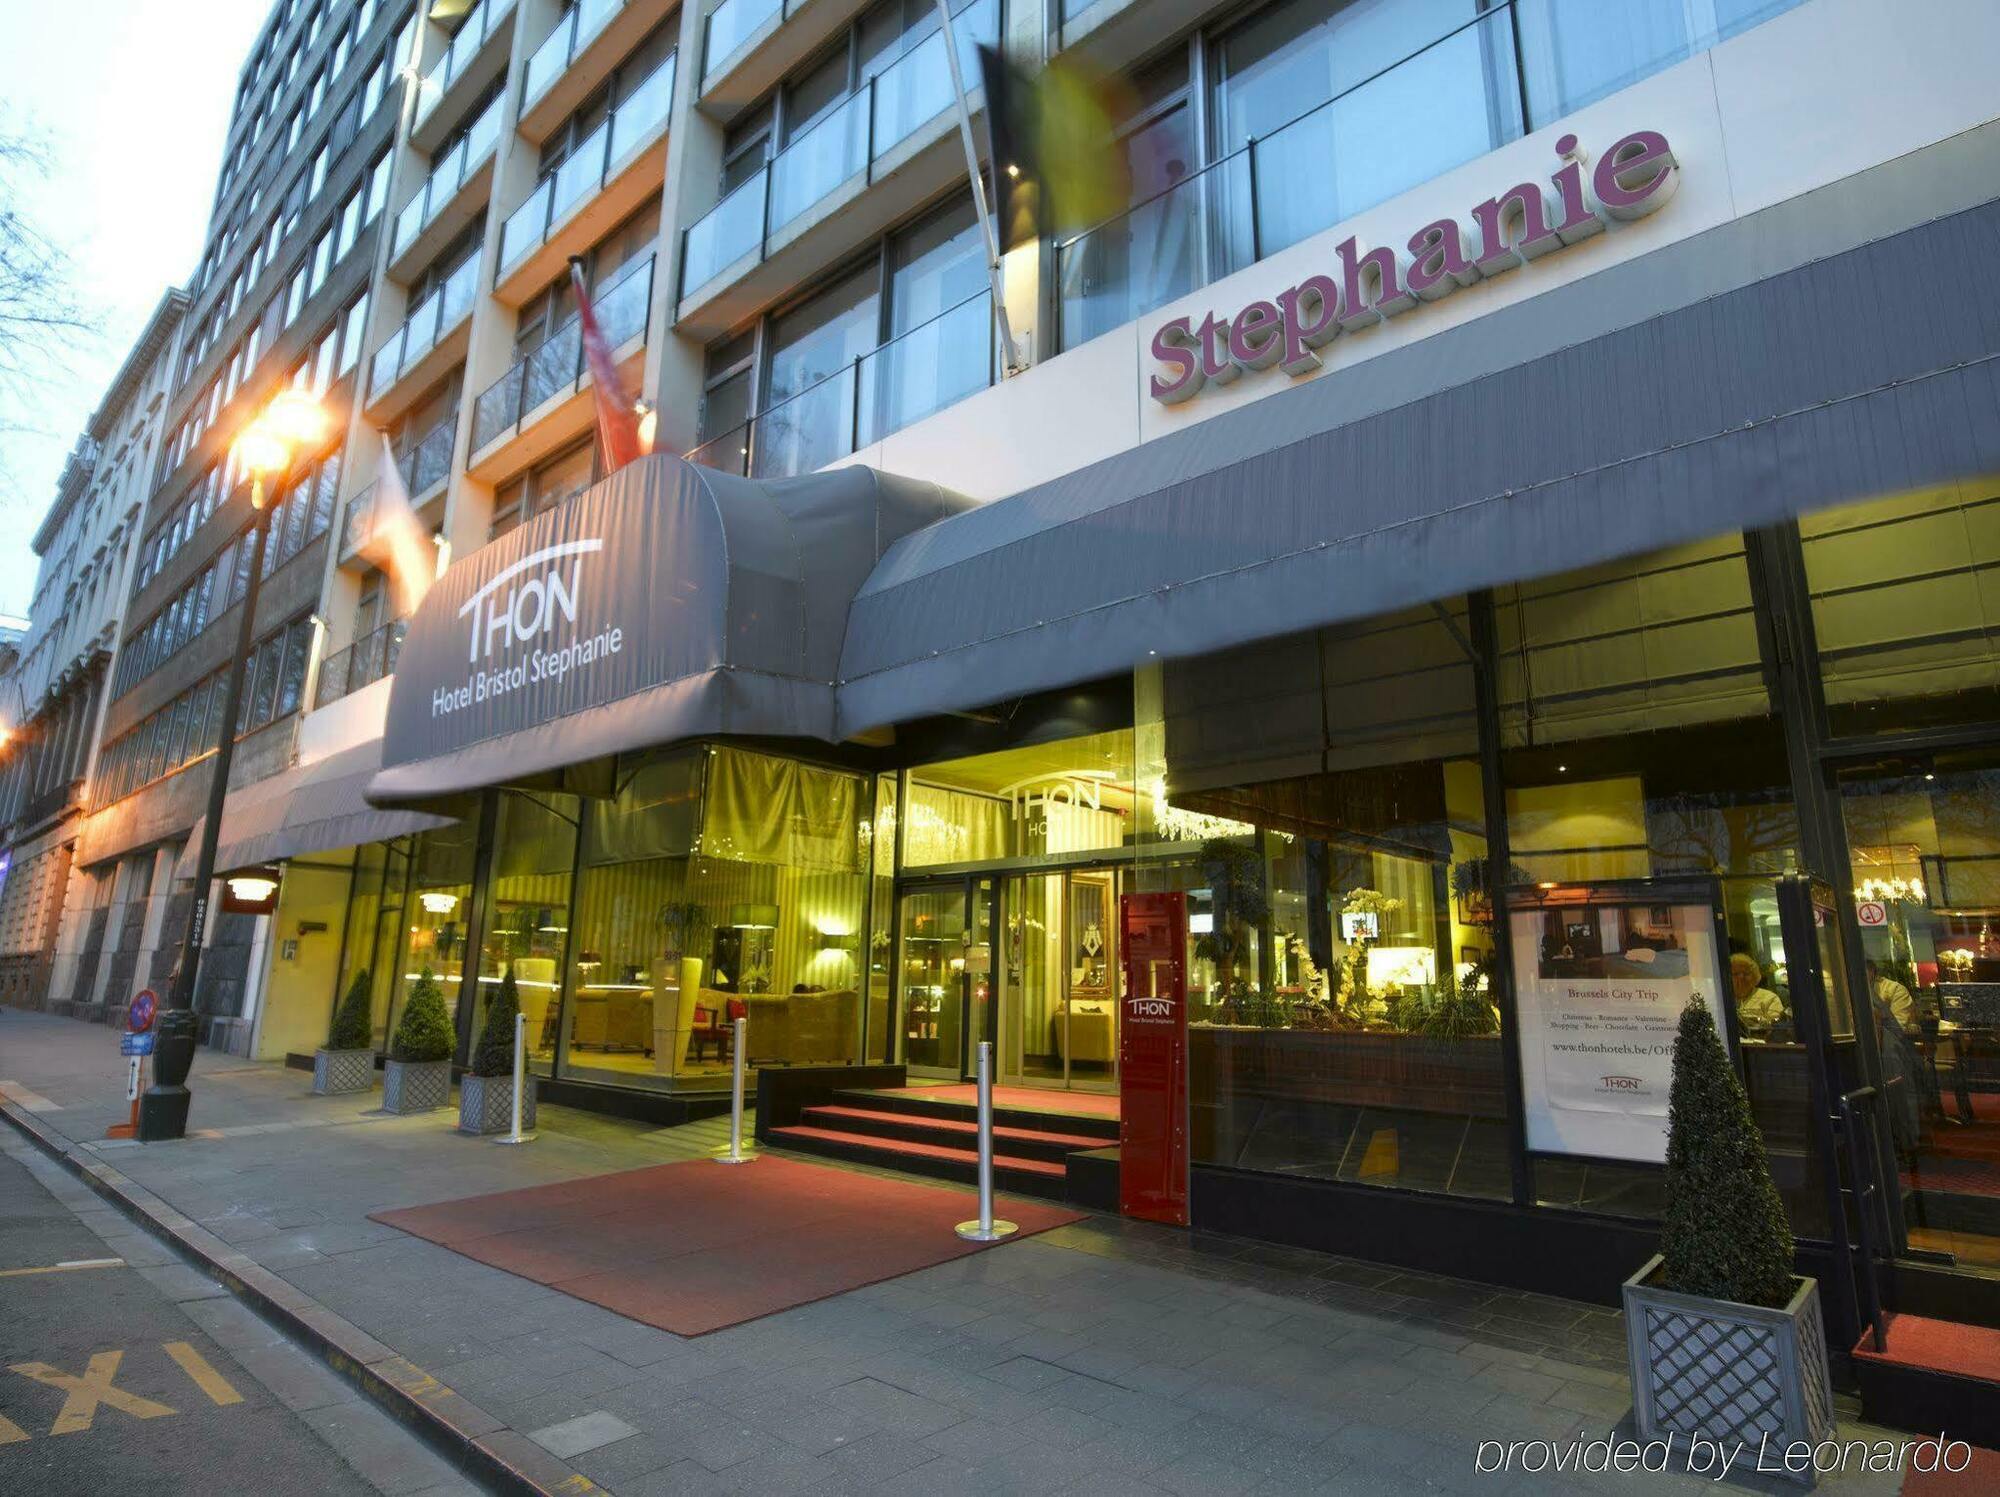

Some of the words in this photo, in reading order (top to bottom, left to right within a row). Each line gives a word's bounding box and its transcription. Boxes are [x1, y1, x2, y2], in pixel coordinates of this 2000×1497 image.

[1150, 130, 1678, 402] Stephanie
[459, 538, 603, 664] THON
[432, 675, 473, 717] Hotel
[475, 655, 527, 704] Bristol
[530, 623, 623, 684] Stephanie
[998, 770, 1116, 821] THON
[1127, 997, 1176, 1016] THON
[1567, 988, 1609, 1000] Brussels
[1611, 989, 1633, 1001] City
[1636, 990, 1660, 1001] Trip
[1598, 1014, 1628, 1022] Romance
[1635, 1015, 1667, 1023] Valentine
[1600, 1076, 1643, 1089] THON
